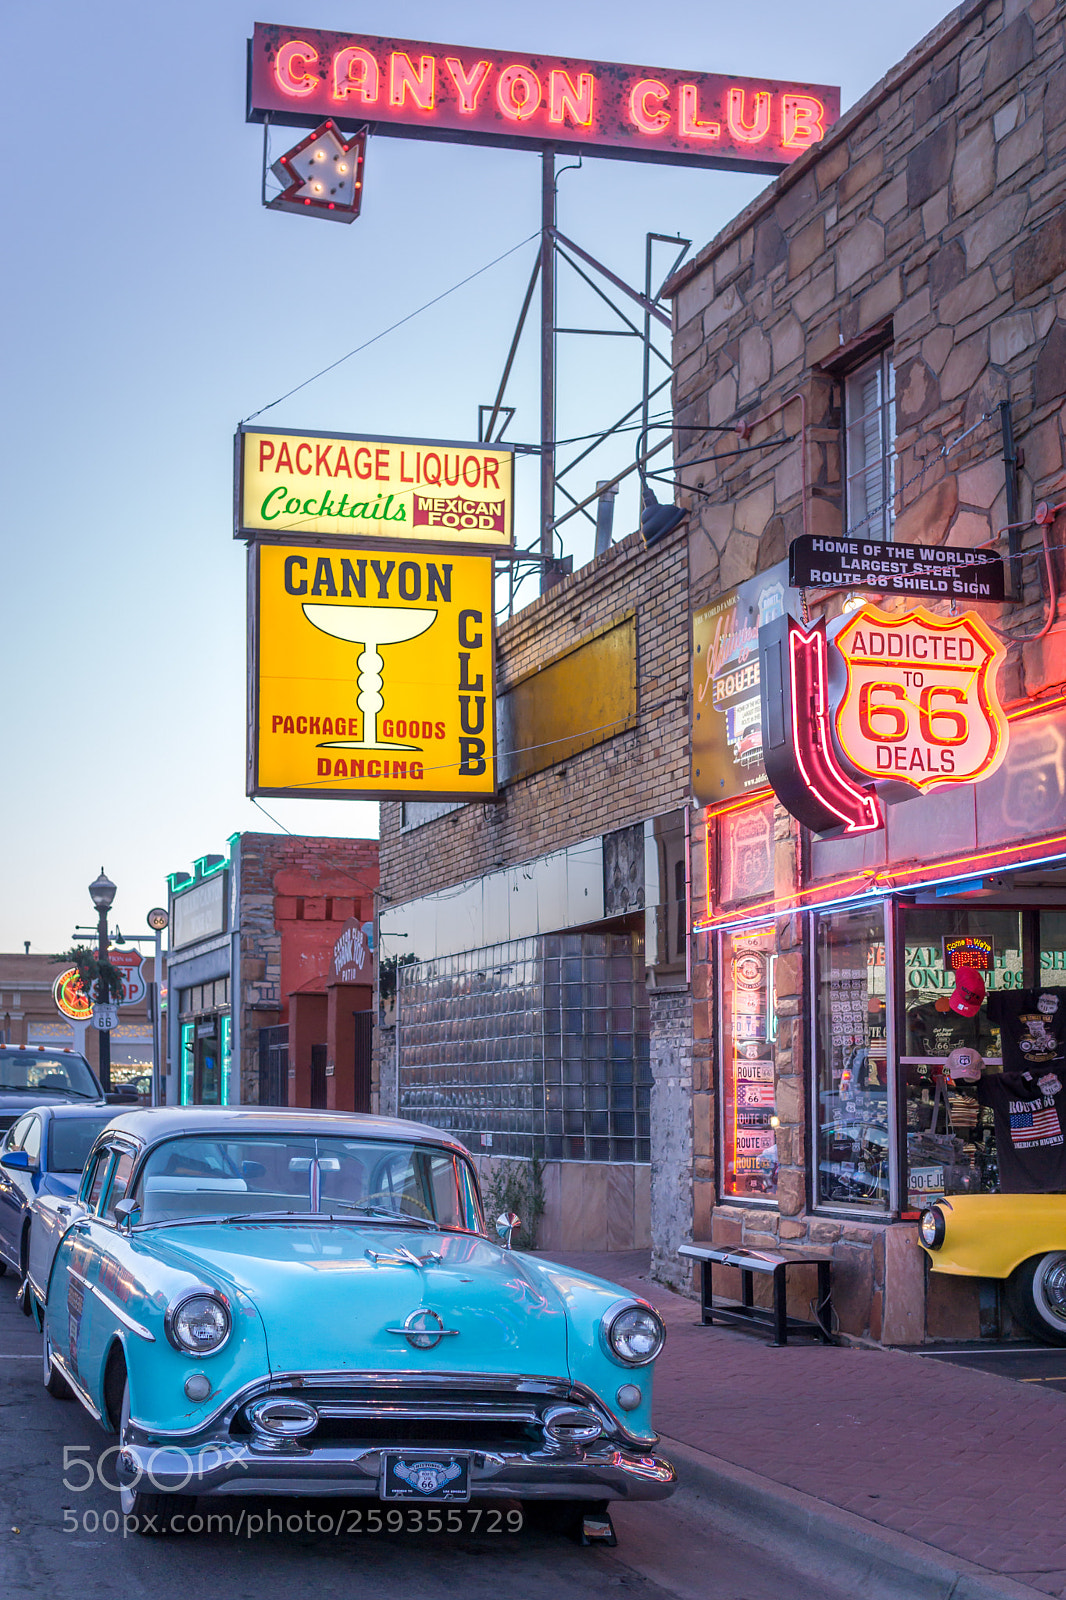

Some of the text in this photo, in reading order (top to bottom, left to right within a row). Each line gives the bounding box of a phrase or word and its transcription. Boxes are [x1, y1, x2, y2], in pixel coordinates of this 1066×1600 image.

[273, 39, 824, 149] CANYON CLUB
[259, 440, 500, 490] PACKAGE LIQUOR
[260, 486, 407, 522] Cocktails
[418, 498, 502, 517] MEXICAN
[428, 512, 495, 530] FOOD
[812, 539, 858, 555] HOME
[863, 545, 881, 557] OF
[886, 547, 915, 559] THE
[841, 556, 909, 574] LARGEST
[284, 555, 454, 602] CANYON
[810, 569, 861, 584] ROUTE
[893, 577, 948, 592] SHIELD
[952, 580, 990, 595] SIGN
[851, 631, 975, 661] ADDICTED
[903, 671, 923, 688] TO
[458, 608, 486, 776] CLUB
[859, 681, 969, 746] 66
[272, 715, 446, 740] PACKAGE GOODS
[317, 757, 424, 780] DANCING
[876, 745, 955, 773] DEALS
[153, 917, 165, 925] 66
[951, 951, 988, 970] OPEN
[98, 1017, 112, 1028] 66
[937, 1042, 949, 1050] 66
[737, 1066, 761, 1078] ROUTE
[748, 1095, 759, 1103] 66
[1009, 1098, 1043, 1114] ROUTE
[737, 1137, 760, 1149] ROUTE
[737, 1156, 760, 1169] ROUTE
[421, 1480, 434, 1489] 66
